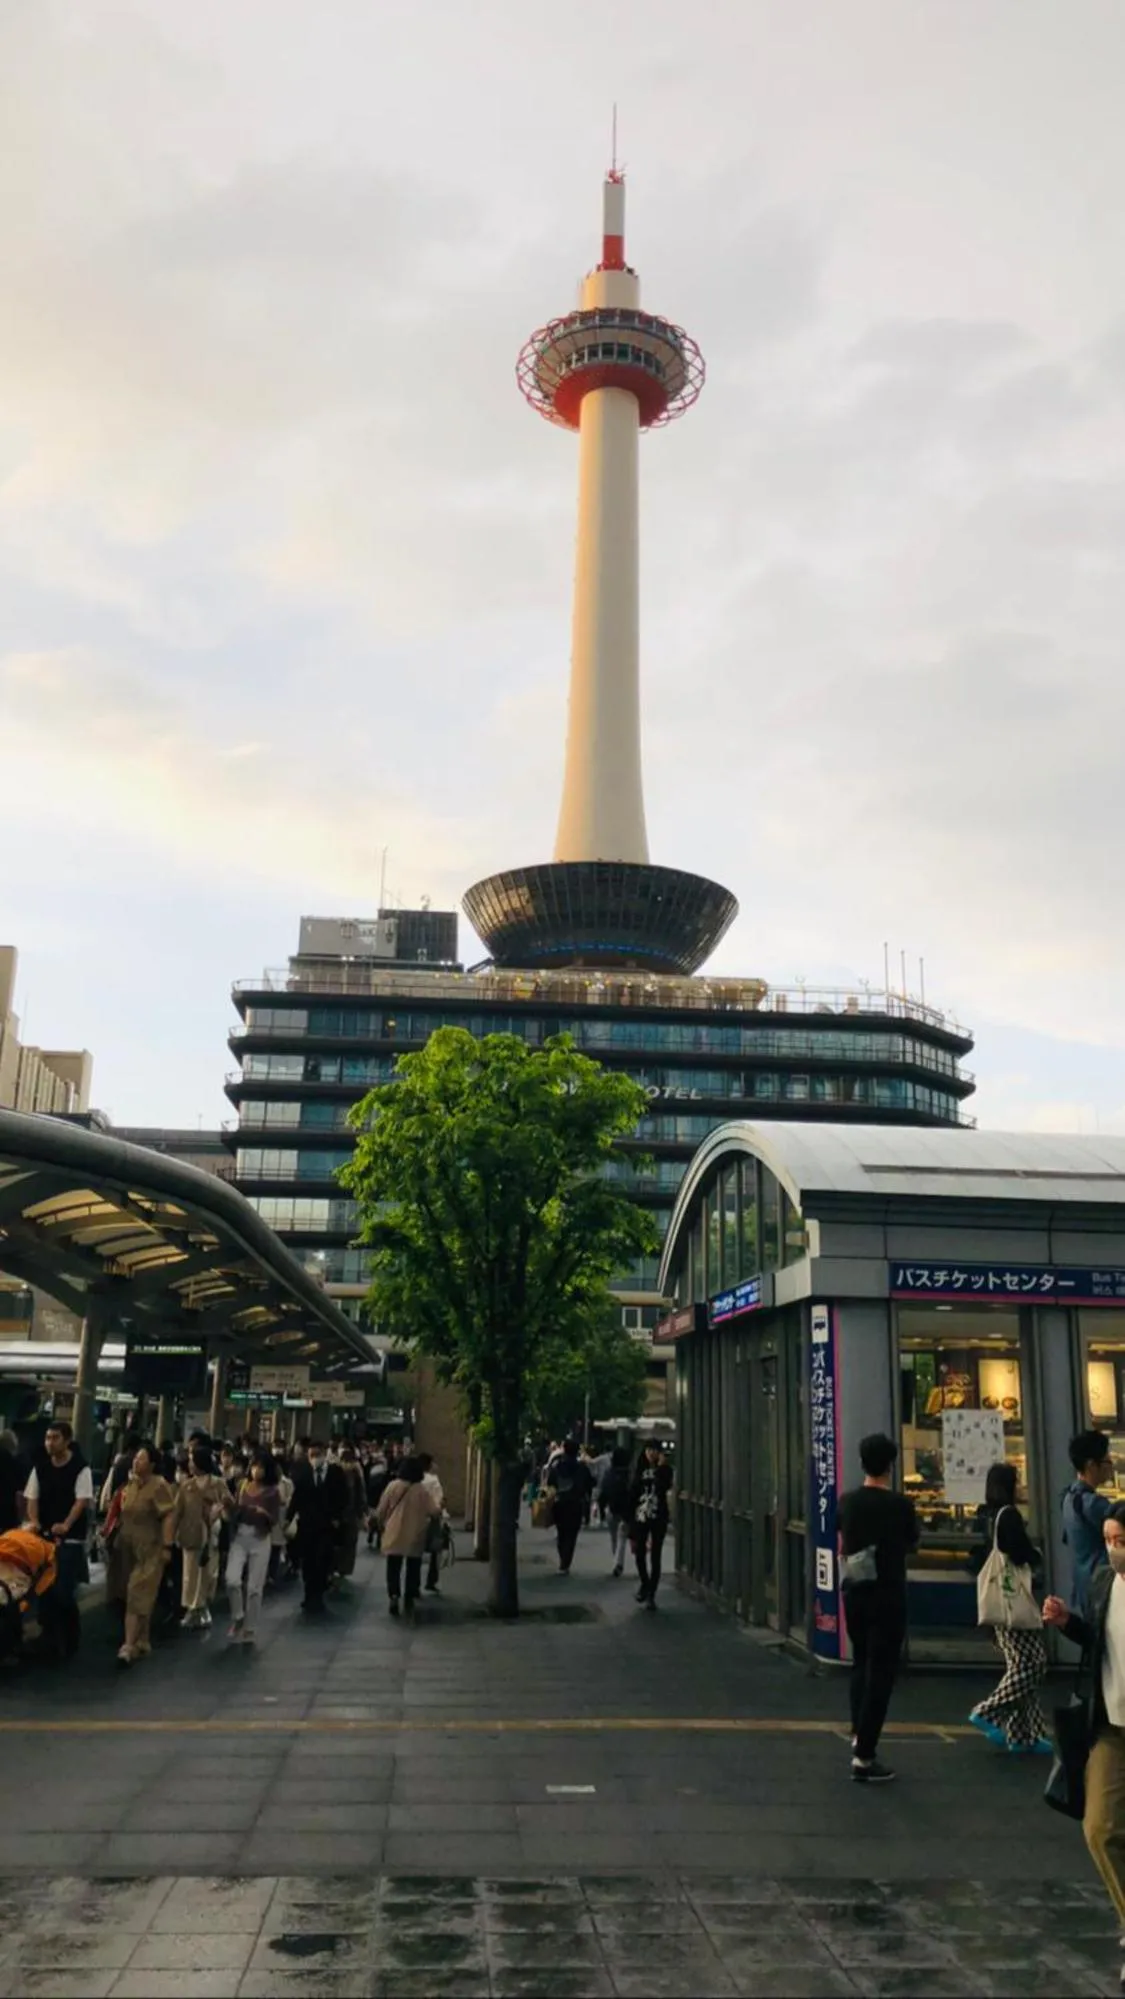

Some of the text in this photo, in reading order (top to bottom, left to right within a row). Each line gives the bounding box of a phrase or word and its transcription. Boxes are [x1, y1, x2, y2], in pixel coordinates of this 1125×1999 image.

[645, 1085, 702, 1100] OTEL
[896, 1268, 1076, 1292] バスチケットセンター
[1092, 1272, 1112, 1282] Bus
